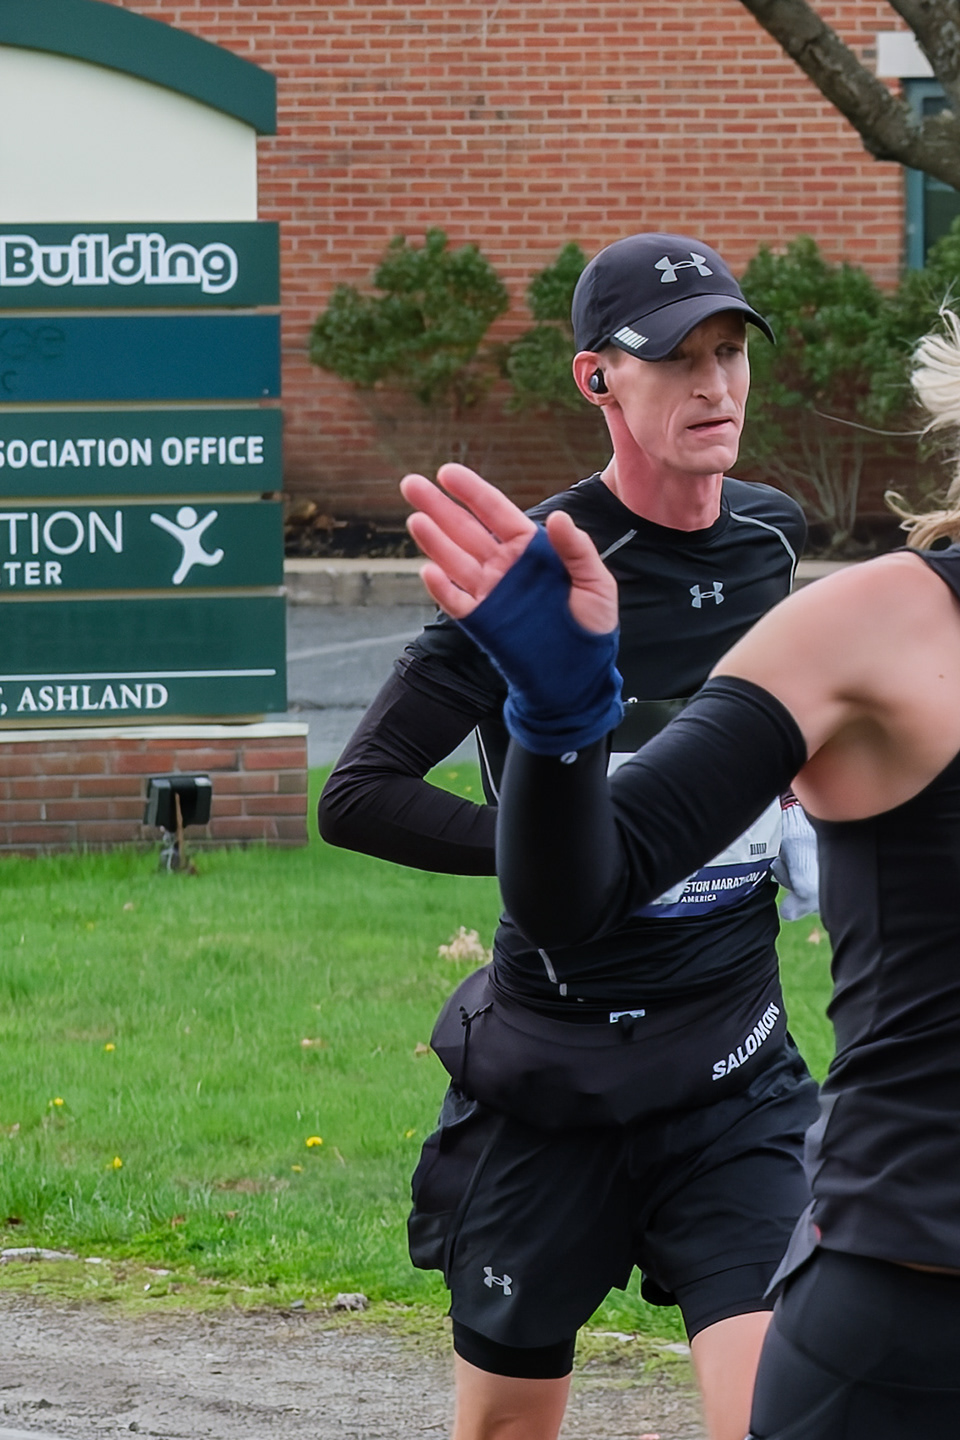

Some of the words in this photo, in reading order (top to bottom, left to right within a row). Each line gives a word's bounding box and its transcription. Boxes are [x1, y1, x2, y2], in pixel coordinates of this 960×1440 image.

[0, 233, 238, 294] Building
[0, 437, 152, 468] OCIATION
[161, 436, 264, 466] OFFICE
[16, 683, 168, 712] ASHLAND
[712, 1002, 780, 1081] SALOMON
